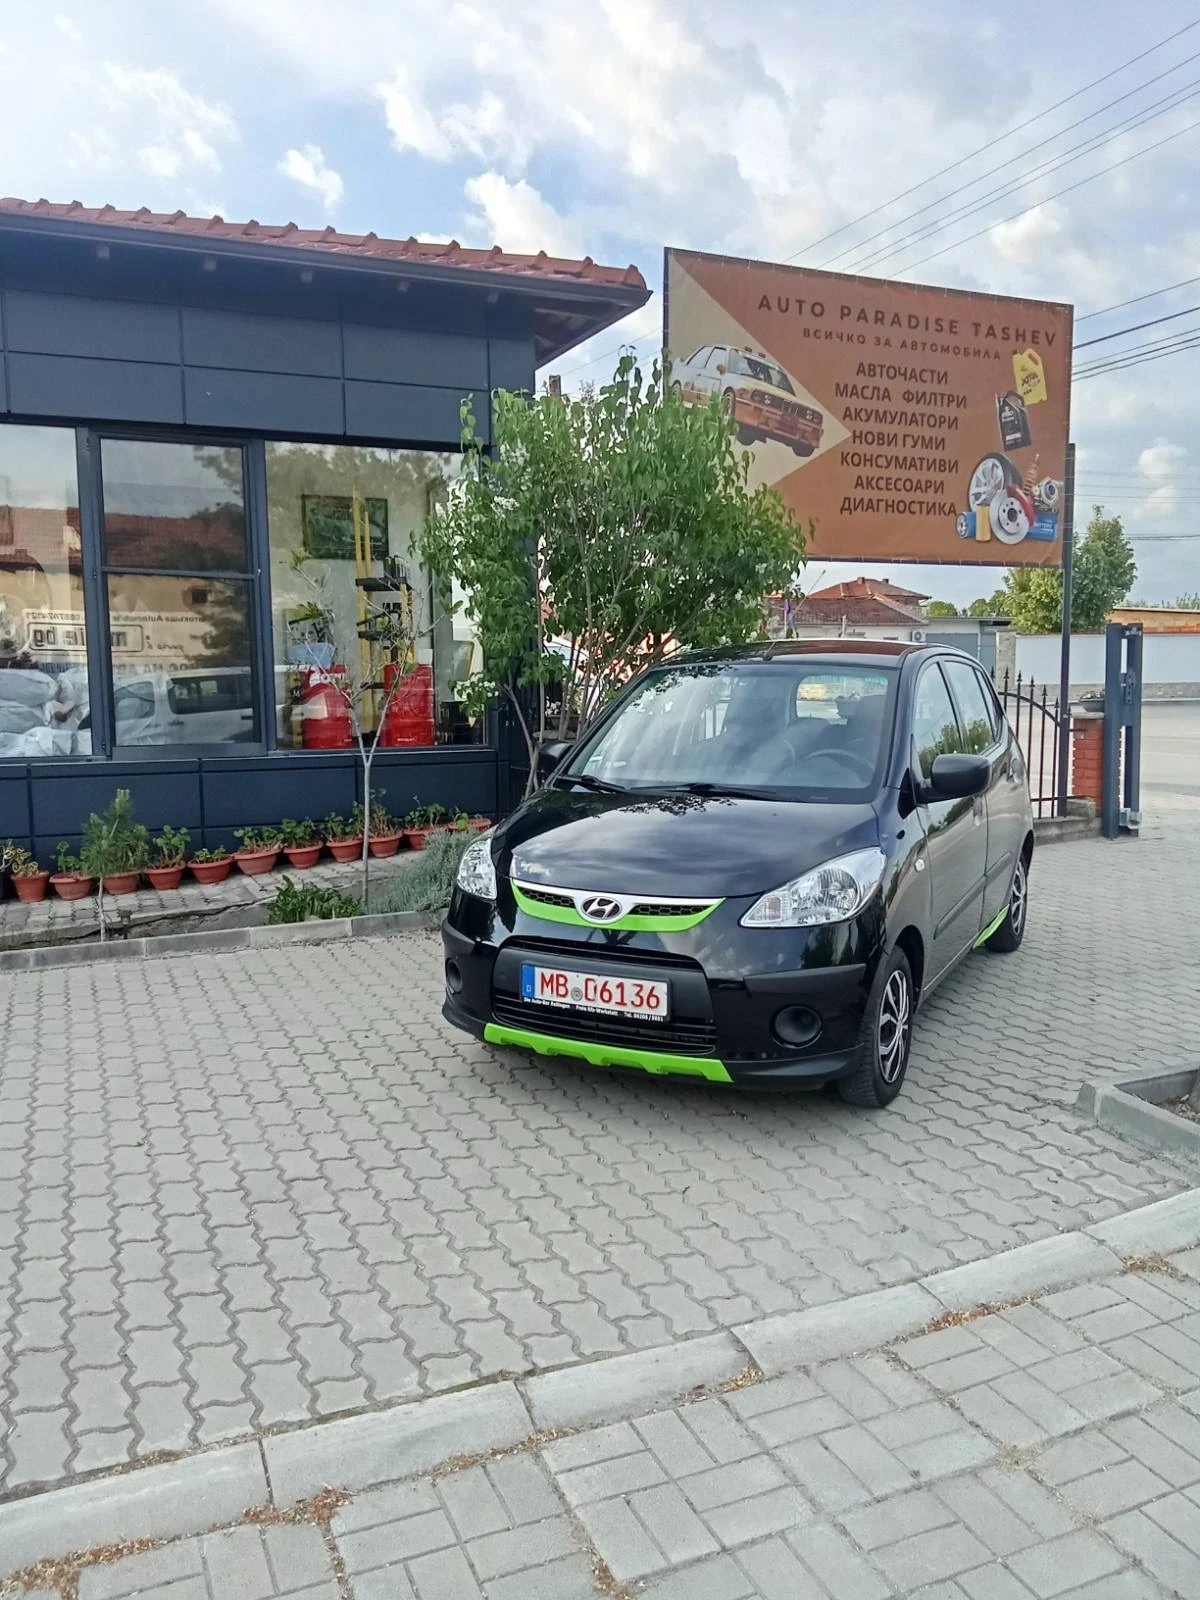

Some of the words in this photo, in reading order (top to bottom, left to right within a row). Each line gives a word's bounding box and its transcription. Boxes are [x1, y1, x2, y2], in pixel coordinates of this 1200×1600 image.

[758, 294, 825, 318] AUTO
[840, 305, 959, 335] PARADISE
[971, 322, 1056, 346] TASHEV
[802, 327, 867, 345] ВСИЧКО
[873, 336, 892, 347] ЗА
[899, 339, 1002, 361] АВТОМОБИЛА
[855, 361, 949, 385] АВТОЧАСТИ
[834, 382, 892, 403] МАСЛА
[902, 389, 967, 409] ФИЛТРИ
[842, 407, 959, 431] АКУМУЛАТОРИ
[851, 430, 898, 448] НОВИ
[902, 433, 946, 451] ГУМИ
[840, 451, 959, 474] КОНСУМАТИВИ
[854, 474, 945, 494] АКСЕСОАРИ
[840, 495, 957, 517] ДИАГНОСТИКА
[540, 971, 569, 998] MB
[584, 977, 661, 1009] 06136
